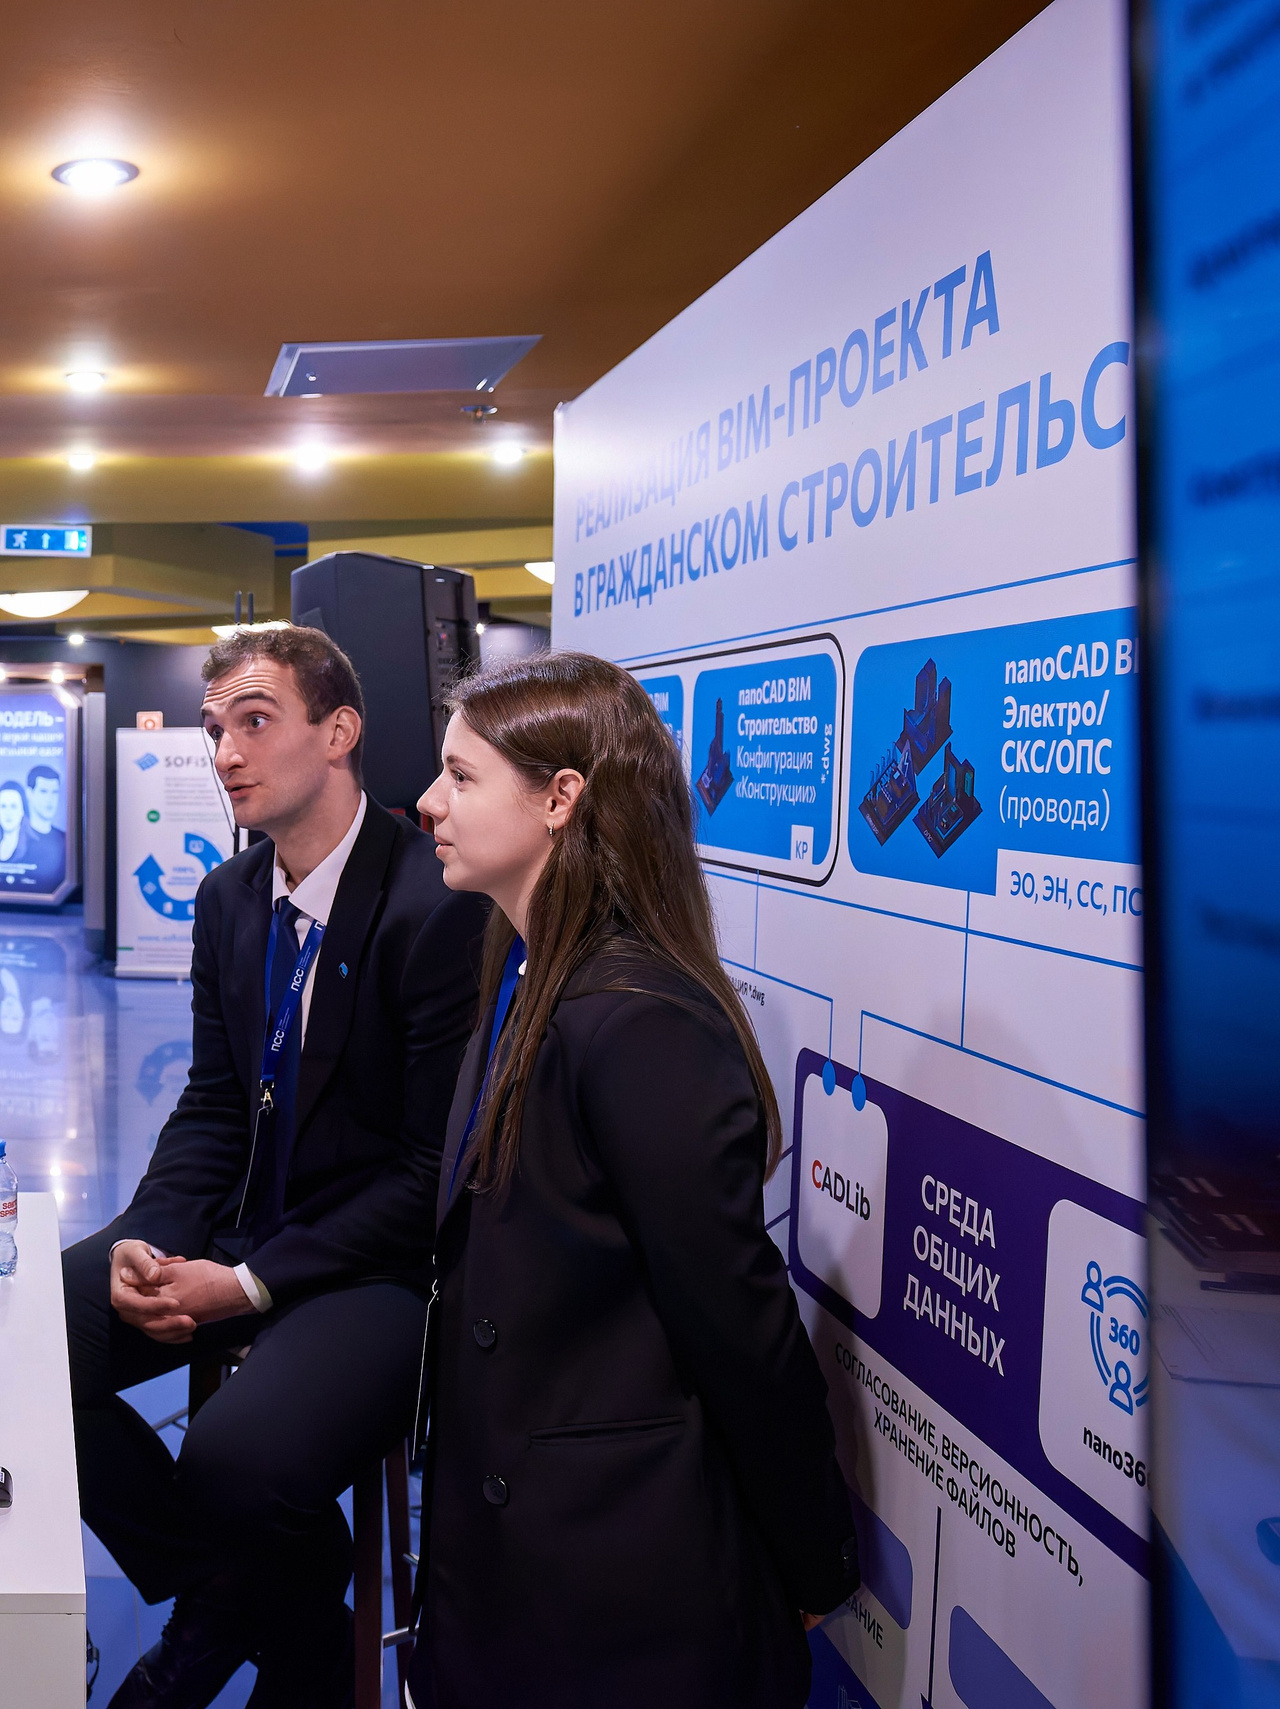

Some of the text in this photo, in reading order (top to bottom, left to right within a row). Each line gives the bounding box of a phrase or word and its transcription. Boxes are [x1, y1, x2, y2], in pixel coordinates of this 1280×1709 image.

[574, 420, 712, 543] РЕАЛИЗАЦИЯ
[717, 249, 1001, 471] BIM-ПРОЕКТА
[573, 572, 584, 618] В
[585, 493, 769, 610] ГРАЖДАНСКОМ
[777, 341, 1130, 553] СТРОИТЕЛЬС
[1004, 640, 1111, 685] nanoCAD
[738, 676, 812, 706] nanoCAD BIM
[1002, 689, 1109, 730] Электро/
[737, 713, 818, 741] Строительство
[736, 744, 813, 775] Конфигурация
[1000, 738, 1113, 776] СКС/ОПС
[735, 776, 817, 806] «Конструкции»
[998, 788, 1111, 831] (провода)
[795, 840, 808, 860] КР
[1009, 871, 1039, 903] ЭО,
[1041, 874, 1074, 909] ЭН,
[1075, 879, 1108, 916] СС,
[290, 968, 304, 991] ПСС
[270, 1030, 285, 1052] ПСС
[811, 1159, 872, 1222] CADLib
[921, 1174, 997, 1249] СРЕДА
[913, 1224, 1001, 1312] ОБЩИХ
[903, 1273, 1006, 1377] ДАННЫХ
[1109, 1315, 1141, 1356] 360
[835, 1341, 1084, 1586] СОГЛАСОВАНИЕ, ВЕРСИОННОСТЬ,
[1083, 1426, 1150, 1489] nano36
[873, 1407, 1017, 1559] ХРАНЕНИЕ ФАЙЛОВ
